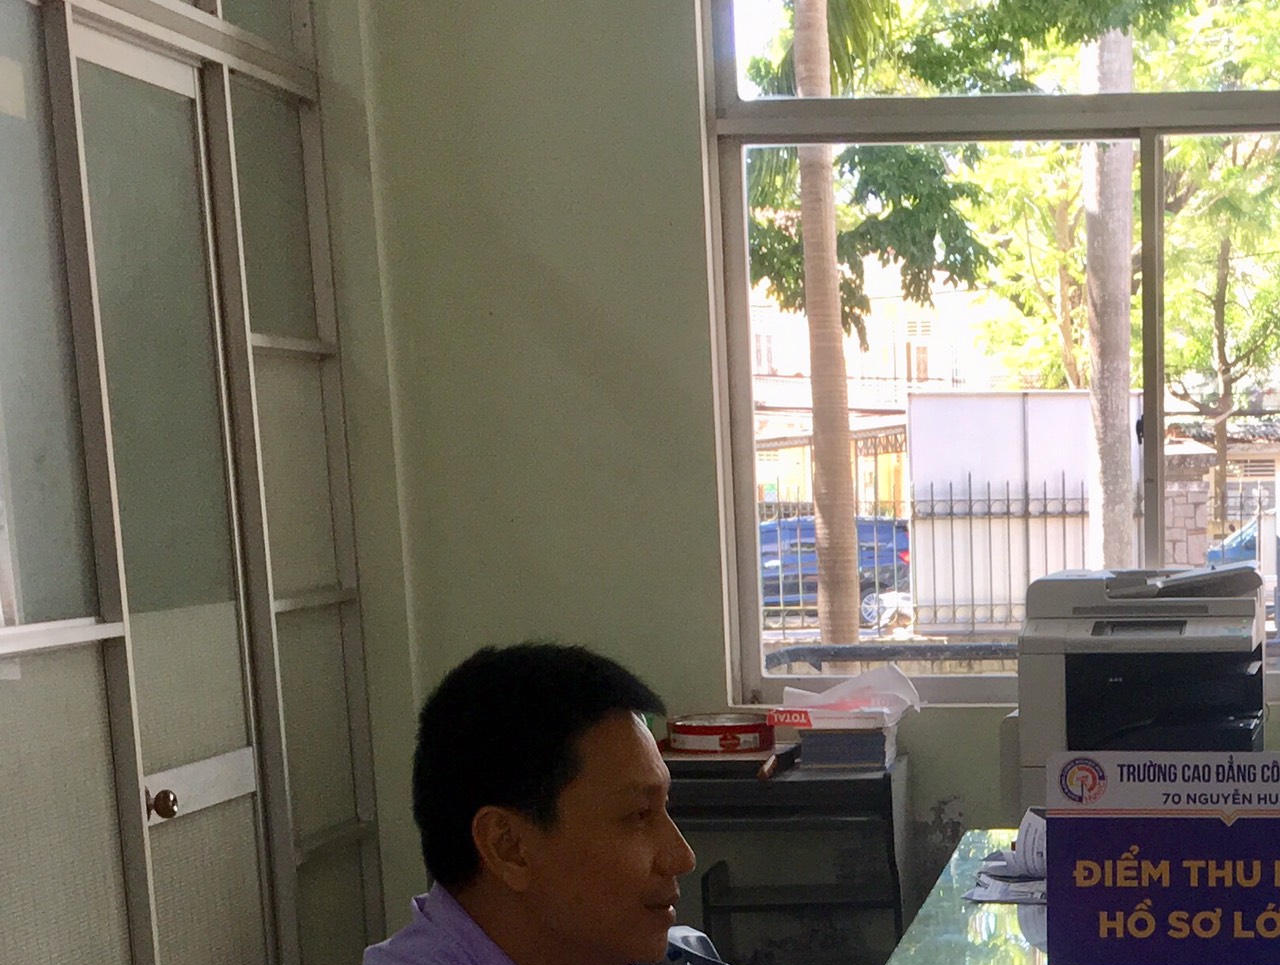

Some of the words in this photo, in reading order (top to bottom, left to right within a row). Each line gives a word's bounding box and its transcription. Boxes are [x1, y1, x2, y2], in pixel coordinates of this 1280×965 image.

[772, 712, 808, 723] TOTAL
[1117, 760, 1177, 783] TRƯỜNG
[1182, 763, 1211, 782] CAO
[1215, 755, 1257, 783] ĐẲNG
[1162, 793, 1182, 805] 70
[1187, 789, 1252, 805] NGUYỄN
[1073, 845, 1170, 887] ĐIỂM
[1182, 860, 1262, 887] THU
[1099, 899, 1156, 938] HỒ
[1167, 908, 1222, 939] SƠ
